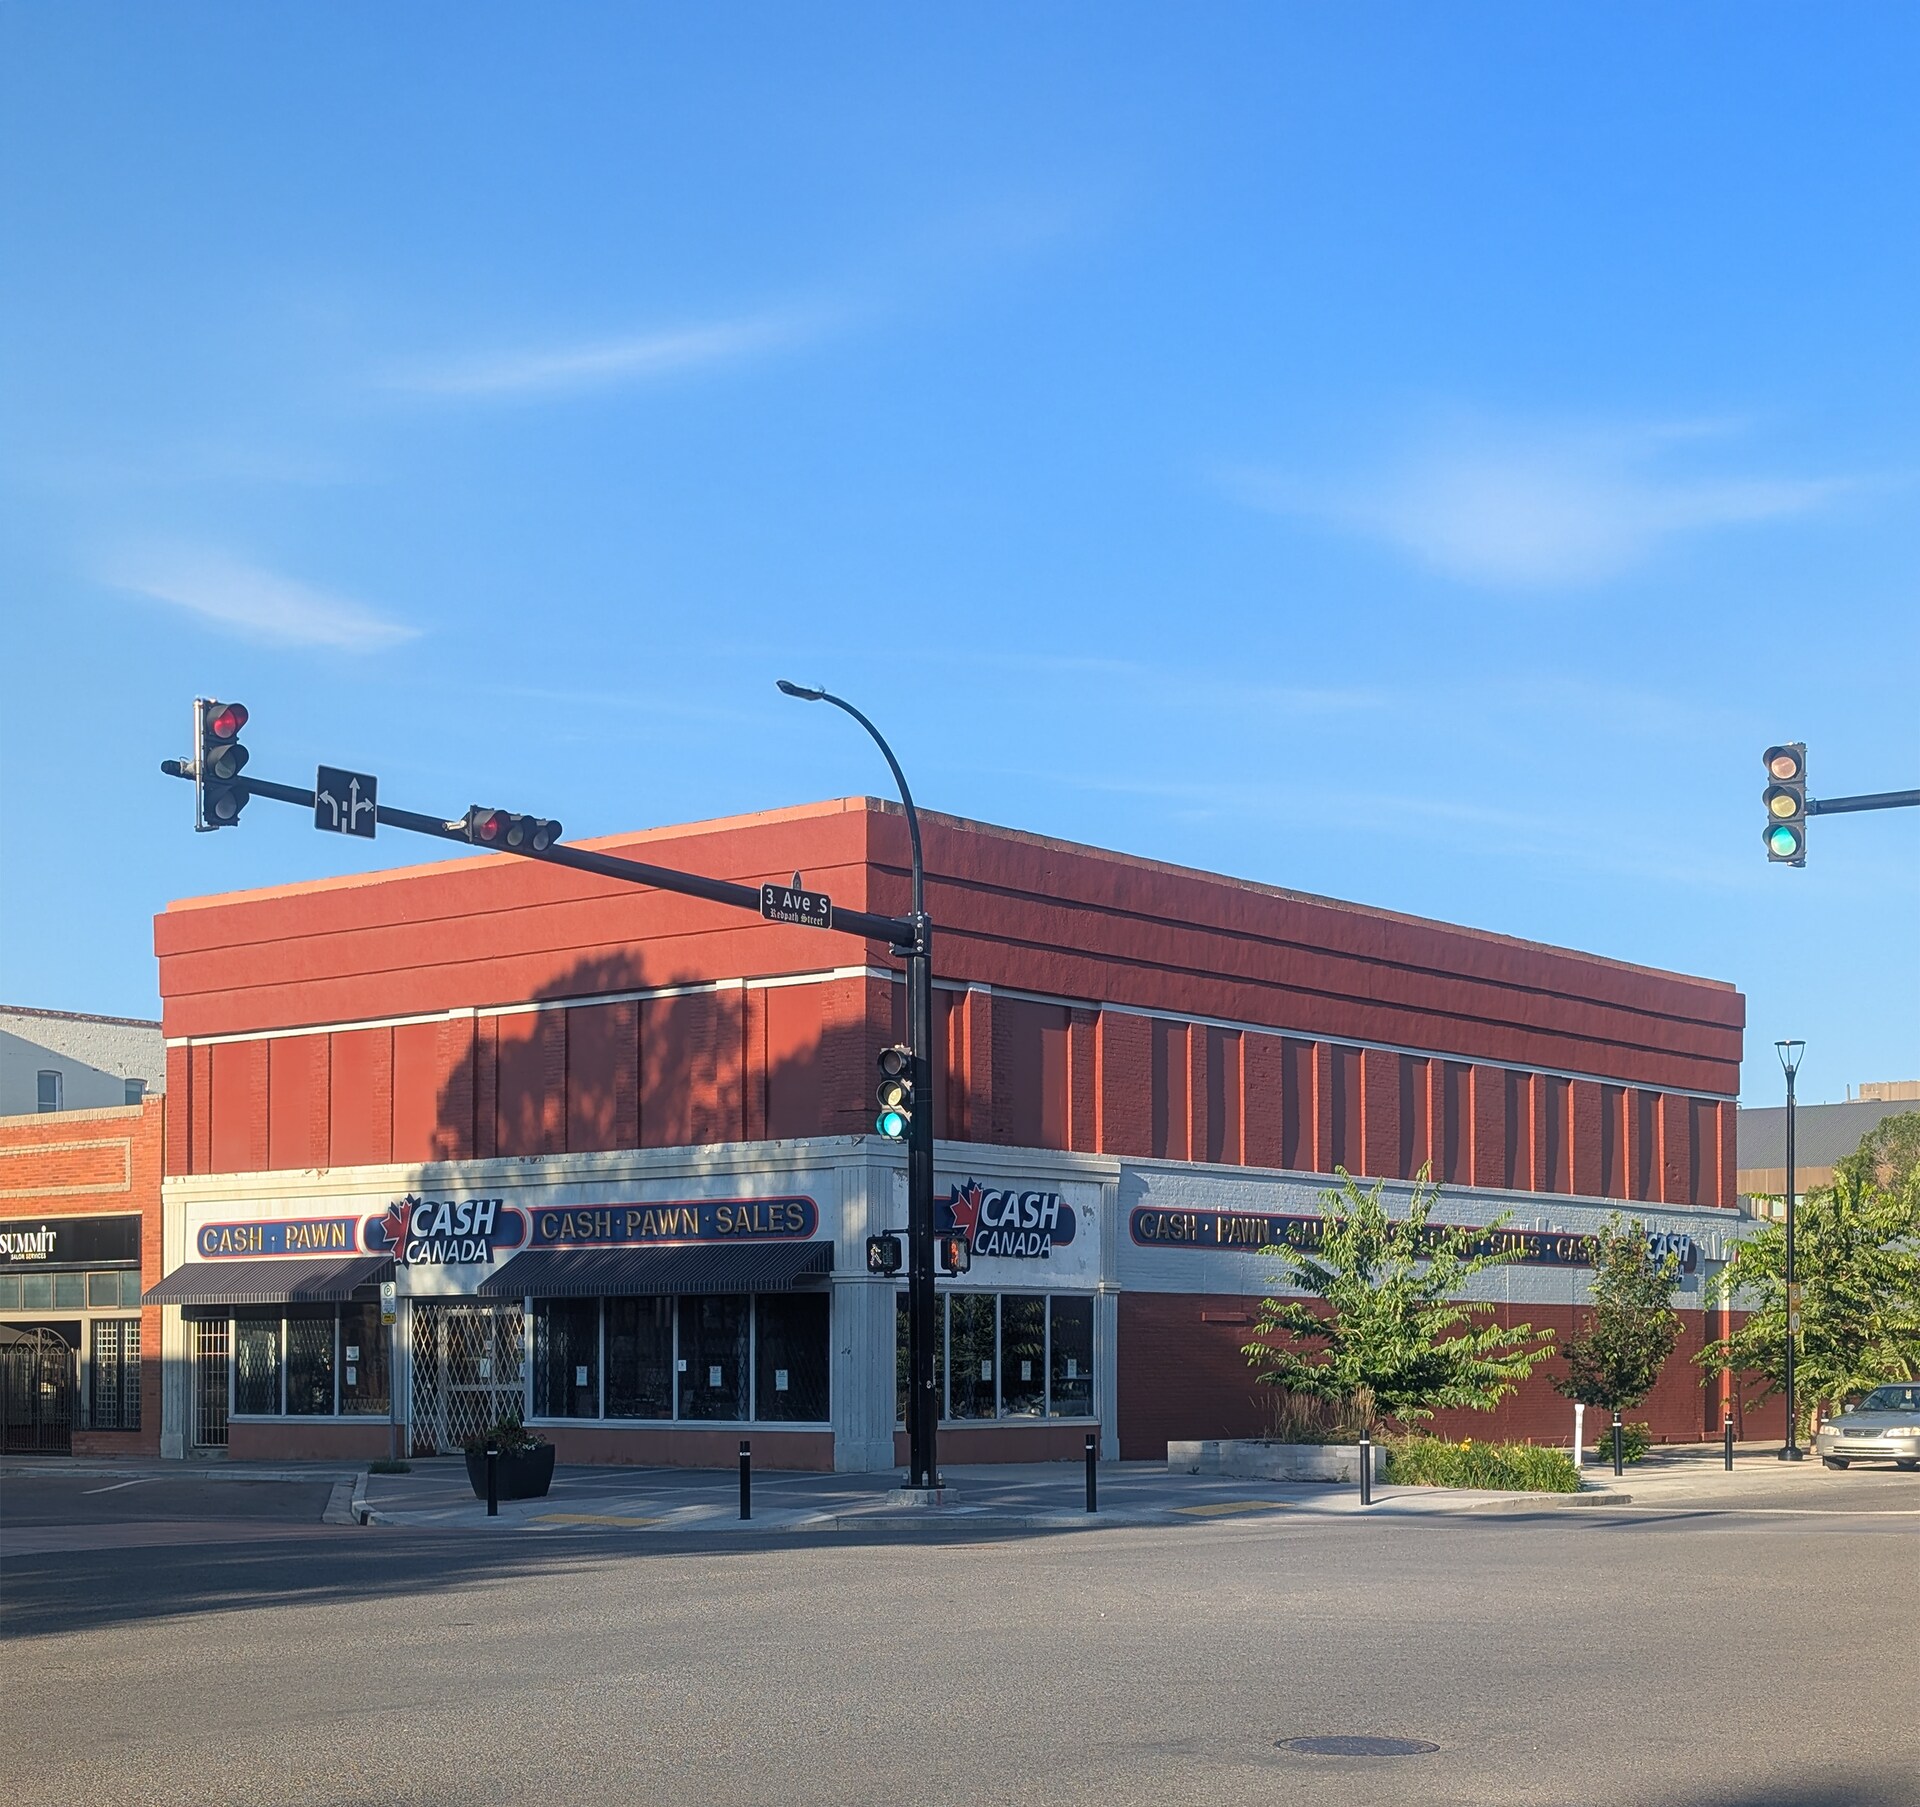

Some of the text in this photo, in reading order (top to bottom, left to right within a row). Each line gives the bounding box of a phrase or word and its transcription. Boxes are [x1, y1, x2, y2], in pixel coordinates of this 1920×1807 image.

[765, 888, 828, 914] 3 Ave S
[770, 908, 824, 926] Redpath Street
[410, 1201, 496, 1237] CASH
[541, 1202, 804, 1240] CASH PAWN SALES
[981, 1191, 1060, 1230] CASH
[202, 1222, 346, 1252] CASH PAWN
[1139, 1212, 1198, 1241] CASH
[1217, 1216, 1271, 1244] PAWN
[406, 1239, 488, 1263] CANADA
[974, 1230, 1052, 1256] CANADA
[1646, 1233, 1691, 1262] CASH
